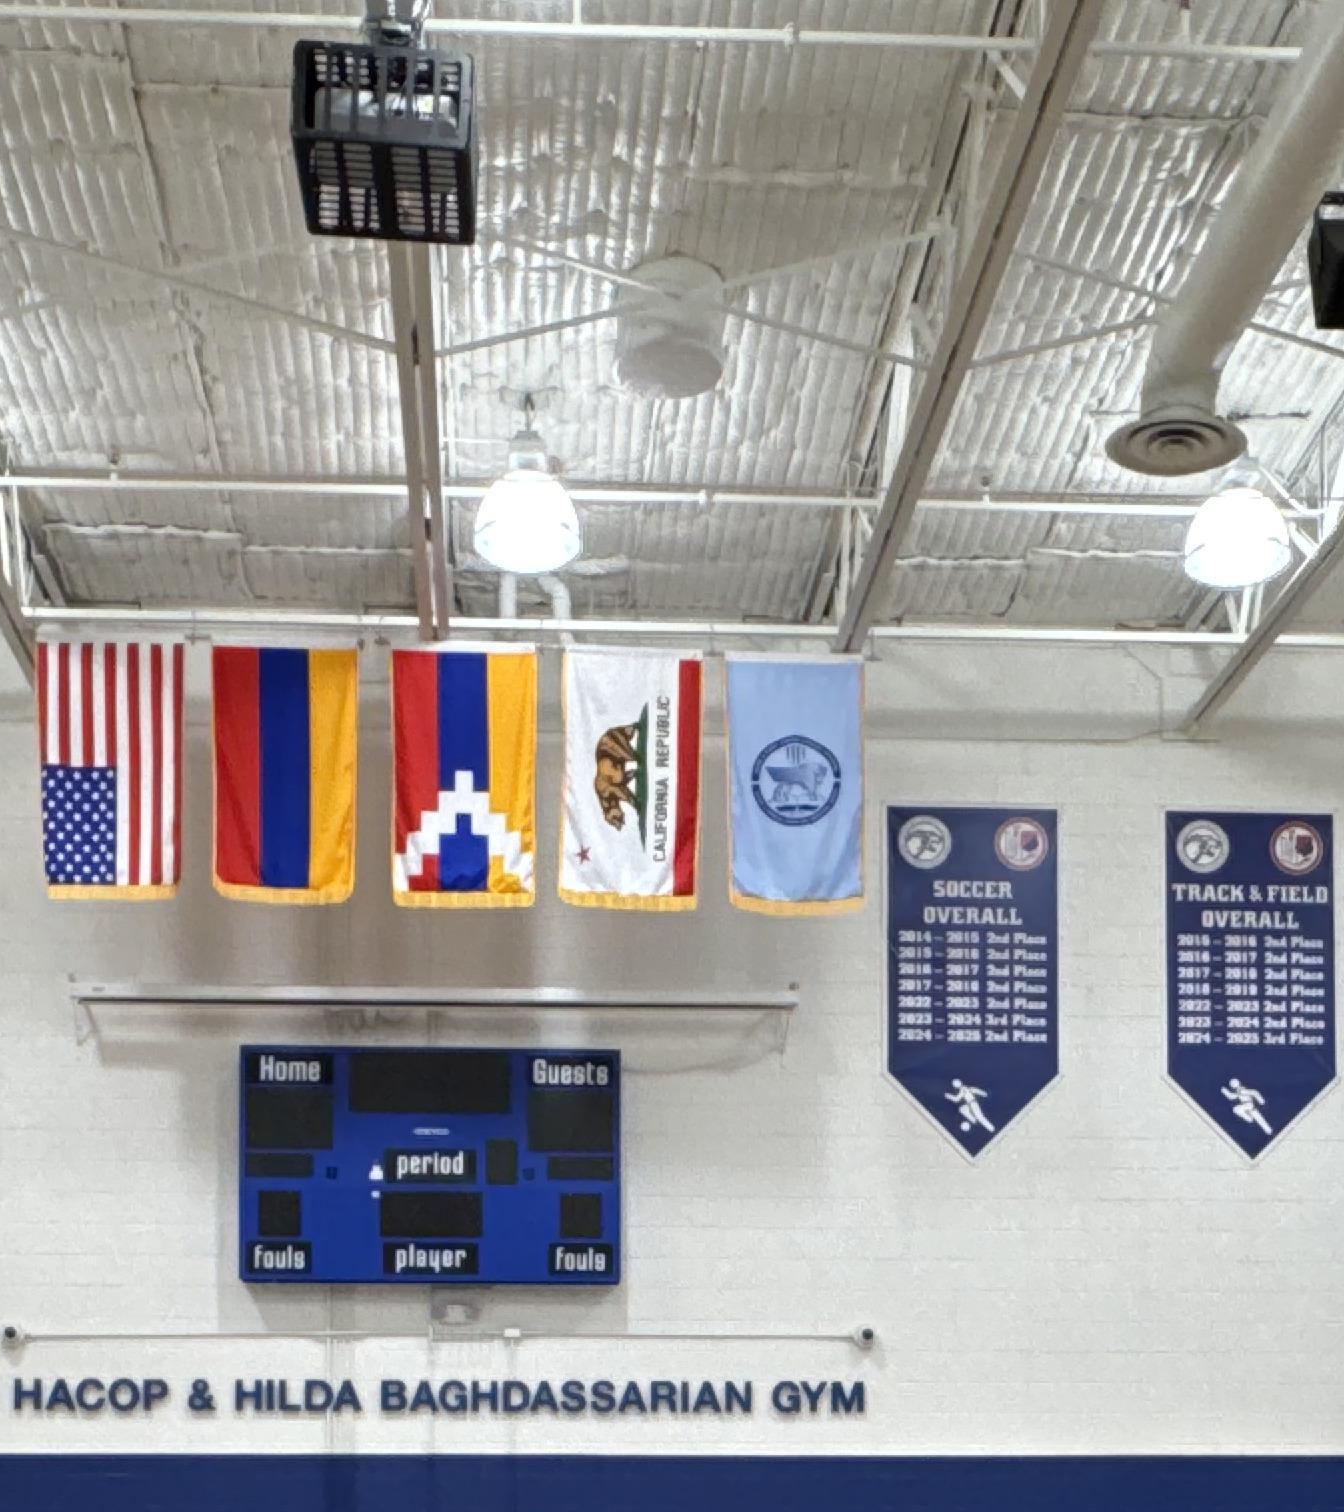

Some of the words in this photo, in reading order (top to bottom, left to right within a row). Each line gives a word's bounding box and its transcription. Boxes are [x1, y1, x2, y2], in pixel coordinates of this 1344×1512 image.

[656, 696, 670, 768] REPUBLIC
[653, 777, 669, 862] CALIFORNIA
[932, 880, 1013, 899] SOCCER
[1172, 884, 1244, 902] TRACK
[1249, 886, 1263, 902] &
[1267, 886, 1328, 903] FIELD
[923, 907, 1023, 925] OVERALL
[1201, 911, 1299, 929] OVERALL
[1013, 933, 1047, 945] Place
[1291, 937, 1323, 948] Place
[1013, 949, 1047, 960] Place
[1291, 953, 1323, 964] Place
[1013, 965, 1047, 977] Place
[1291, 969, 1323, 980] Place
[1013, 981, 1047, 993] Place
[1291, 985, 1323, 996] Place
[1013, 997, 1047, 1009] Place
[1291, 1001, 1325, 1013] Place
[1012, 1014, 1047, 1026] Place
[1291, 1018, 1325, 1029] Place
[1012, 1030, 1047, 1042] Place
[1291, 1034, 1325, 1045] Place
[260, 1055, 321, 1082] Home
[533, 1058, 608, 1085] Guests
[397, 1151, 464, 1179] period
[254, 1241, 305, 1269] fouls
[395, 1243, 467, 1273] player
[556, 1247, 606, 1271] fouls
[14, 1378, 169, 1412] HACOP
[188, 1378, 215, 1411] &
[235, 1378, 362, 1412] HILDA
[380, 1380, 752, 1414] BAGHDASSARIAN
[772, 1380, 865, 1414] GYM
